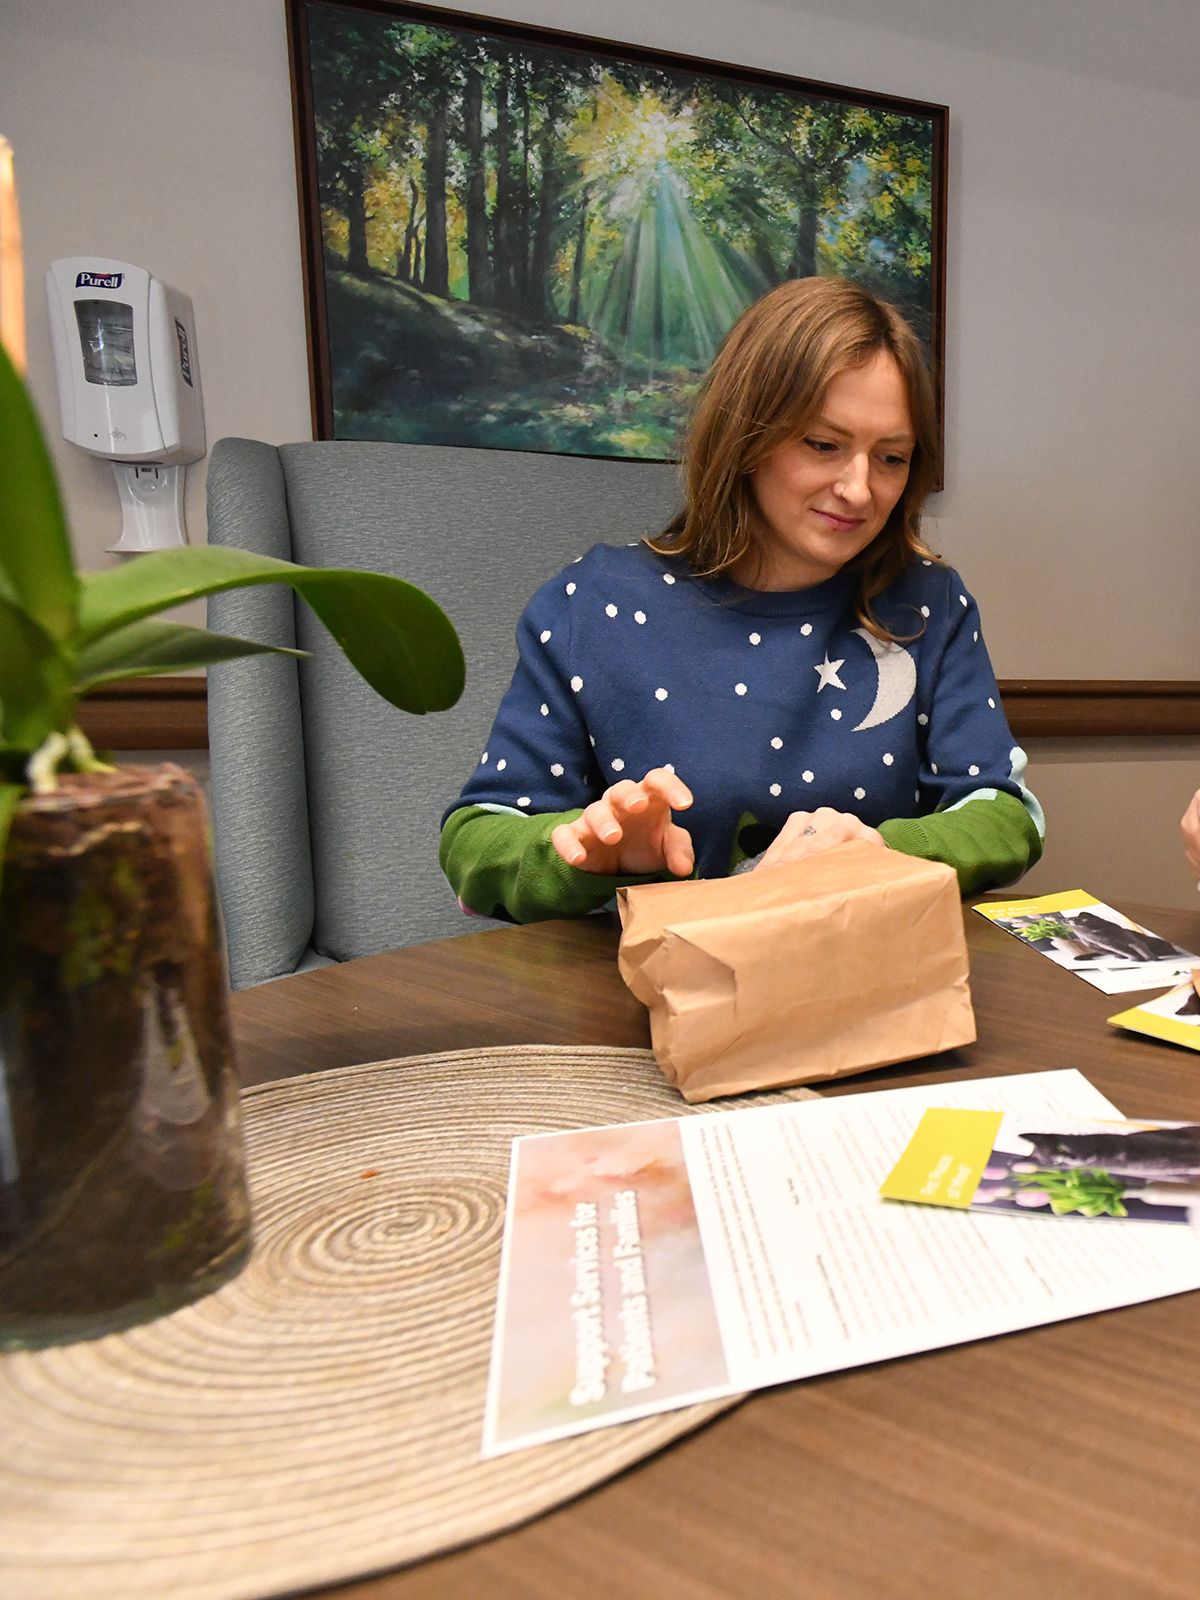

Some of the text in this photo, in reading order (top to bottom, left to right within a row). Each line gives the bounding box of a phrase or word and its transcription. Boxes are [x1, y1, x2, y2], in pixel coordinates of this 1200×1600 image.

[80, 273, 119, 288] Purell
[177, 326, 190, 379] Purell
[919, 1155, 954, 1197] Pet Peace
[946, 1186, 962, 1200] of
[568, 1202, 611, 1406] Support Services for
[609, 1189, 657, 1394] Patients and Families
